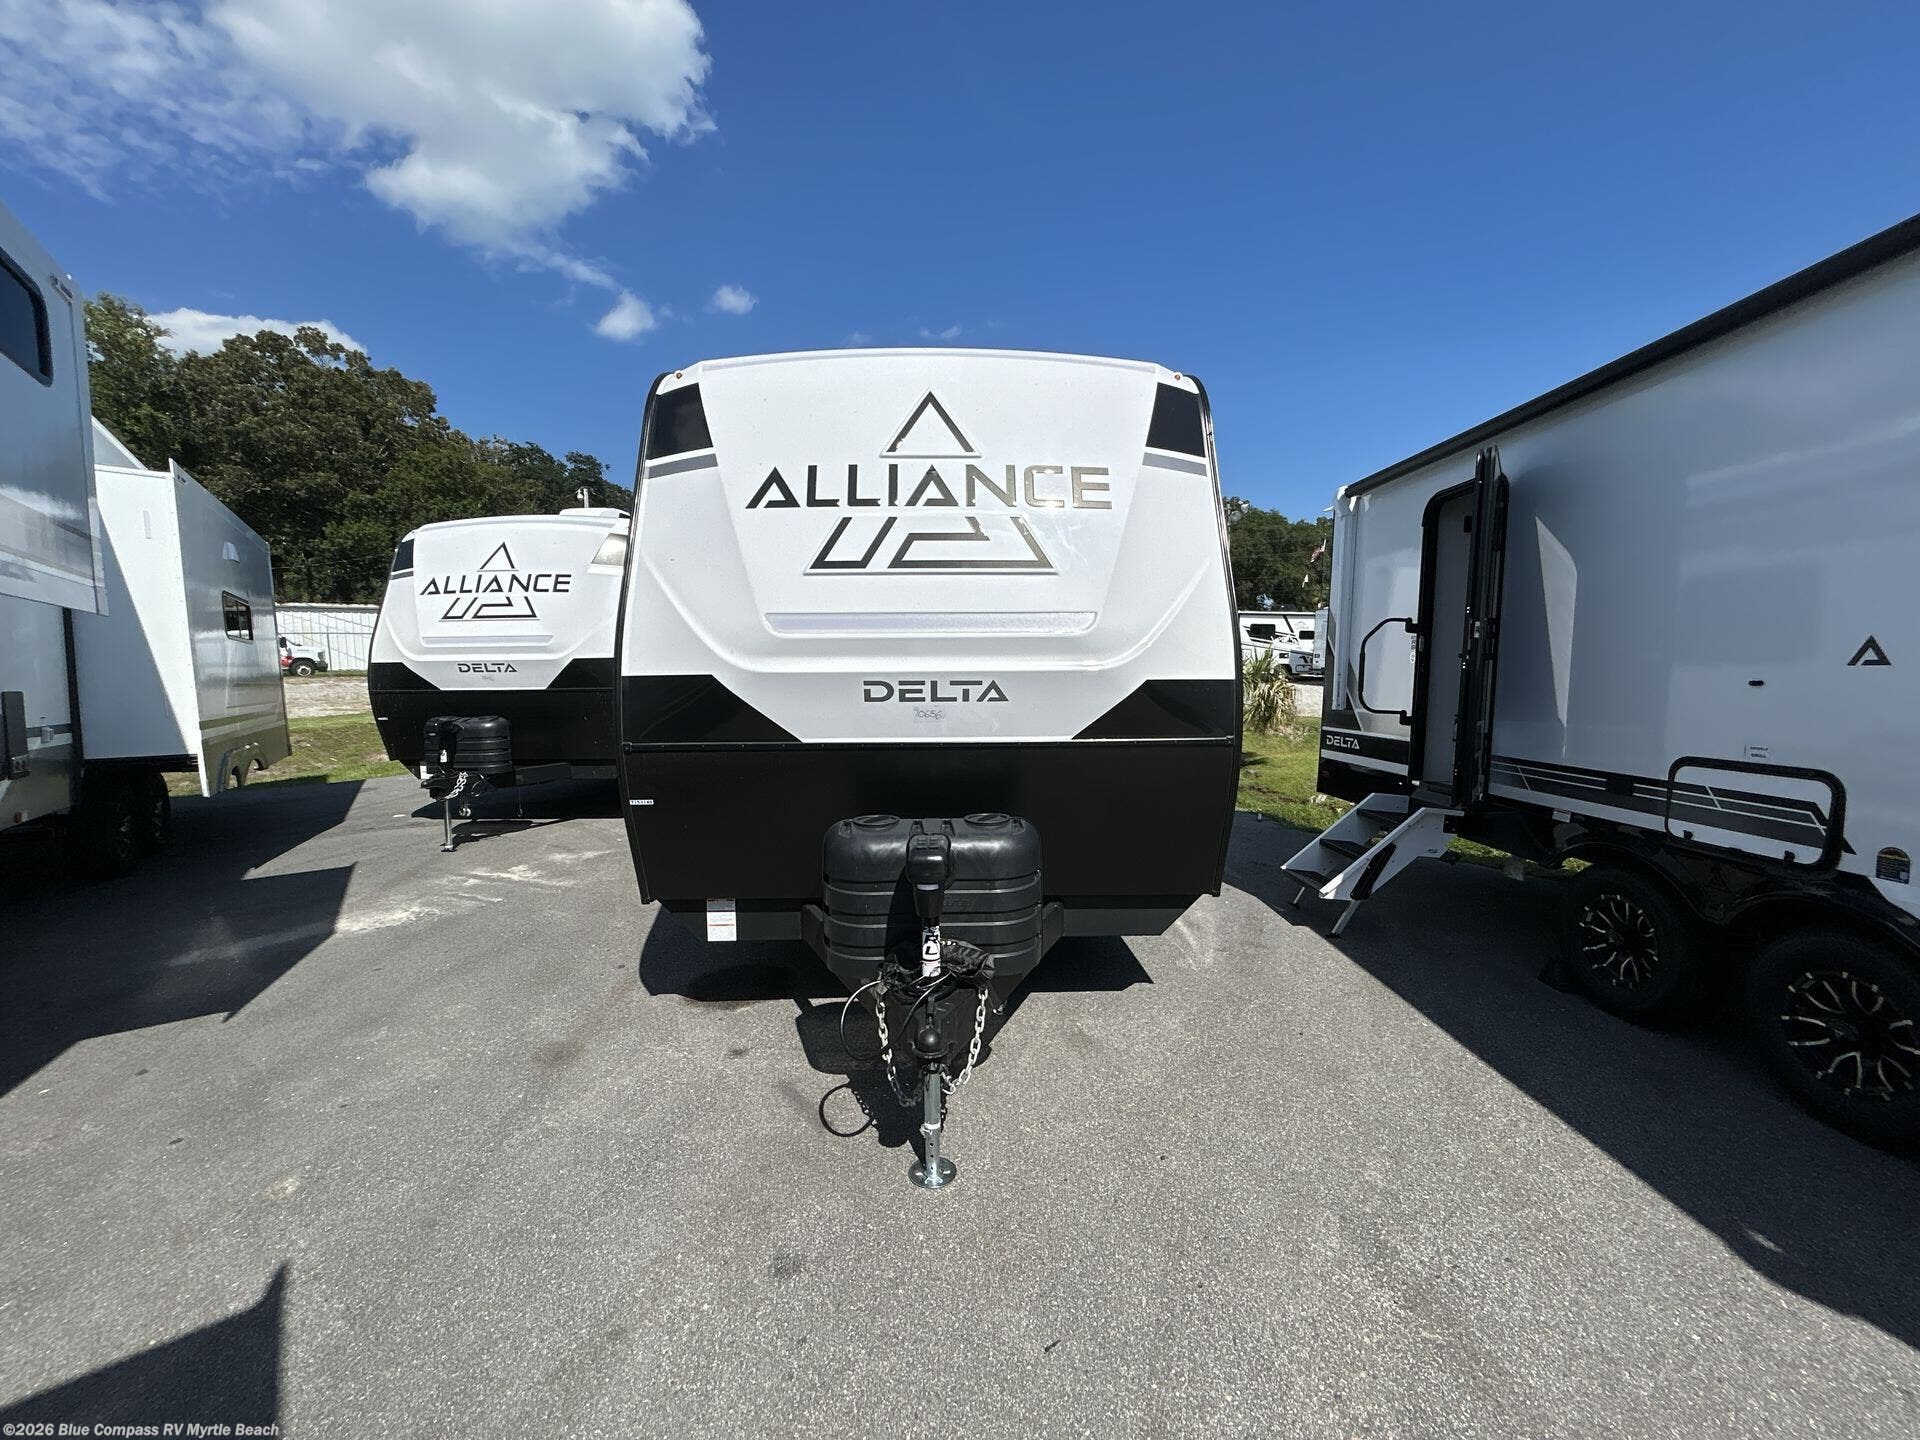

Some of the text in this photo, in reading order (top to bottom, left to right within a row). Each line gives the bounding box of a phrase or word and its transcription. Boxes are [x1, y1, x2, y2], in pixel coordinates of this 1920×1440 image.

[745, 464, 1112, 509] ALLIANCE
[420, 573, 572, 595] ALLIANCE
[457, 662, 518, 673] DELTA
[863, 680, 1009, 702] DELTA
[1326, 734, 1360, 749] DELTA
